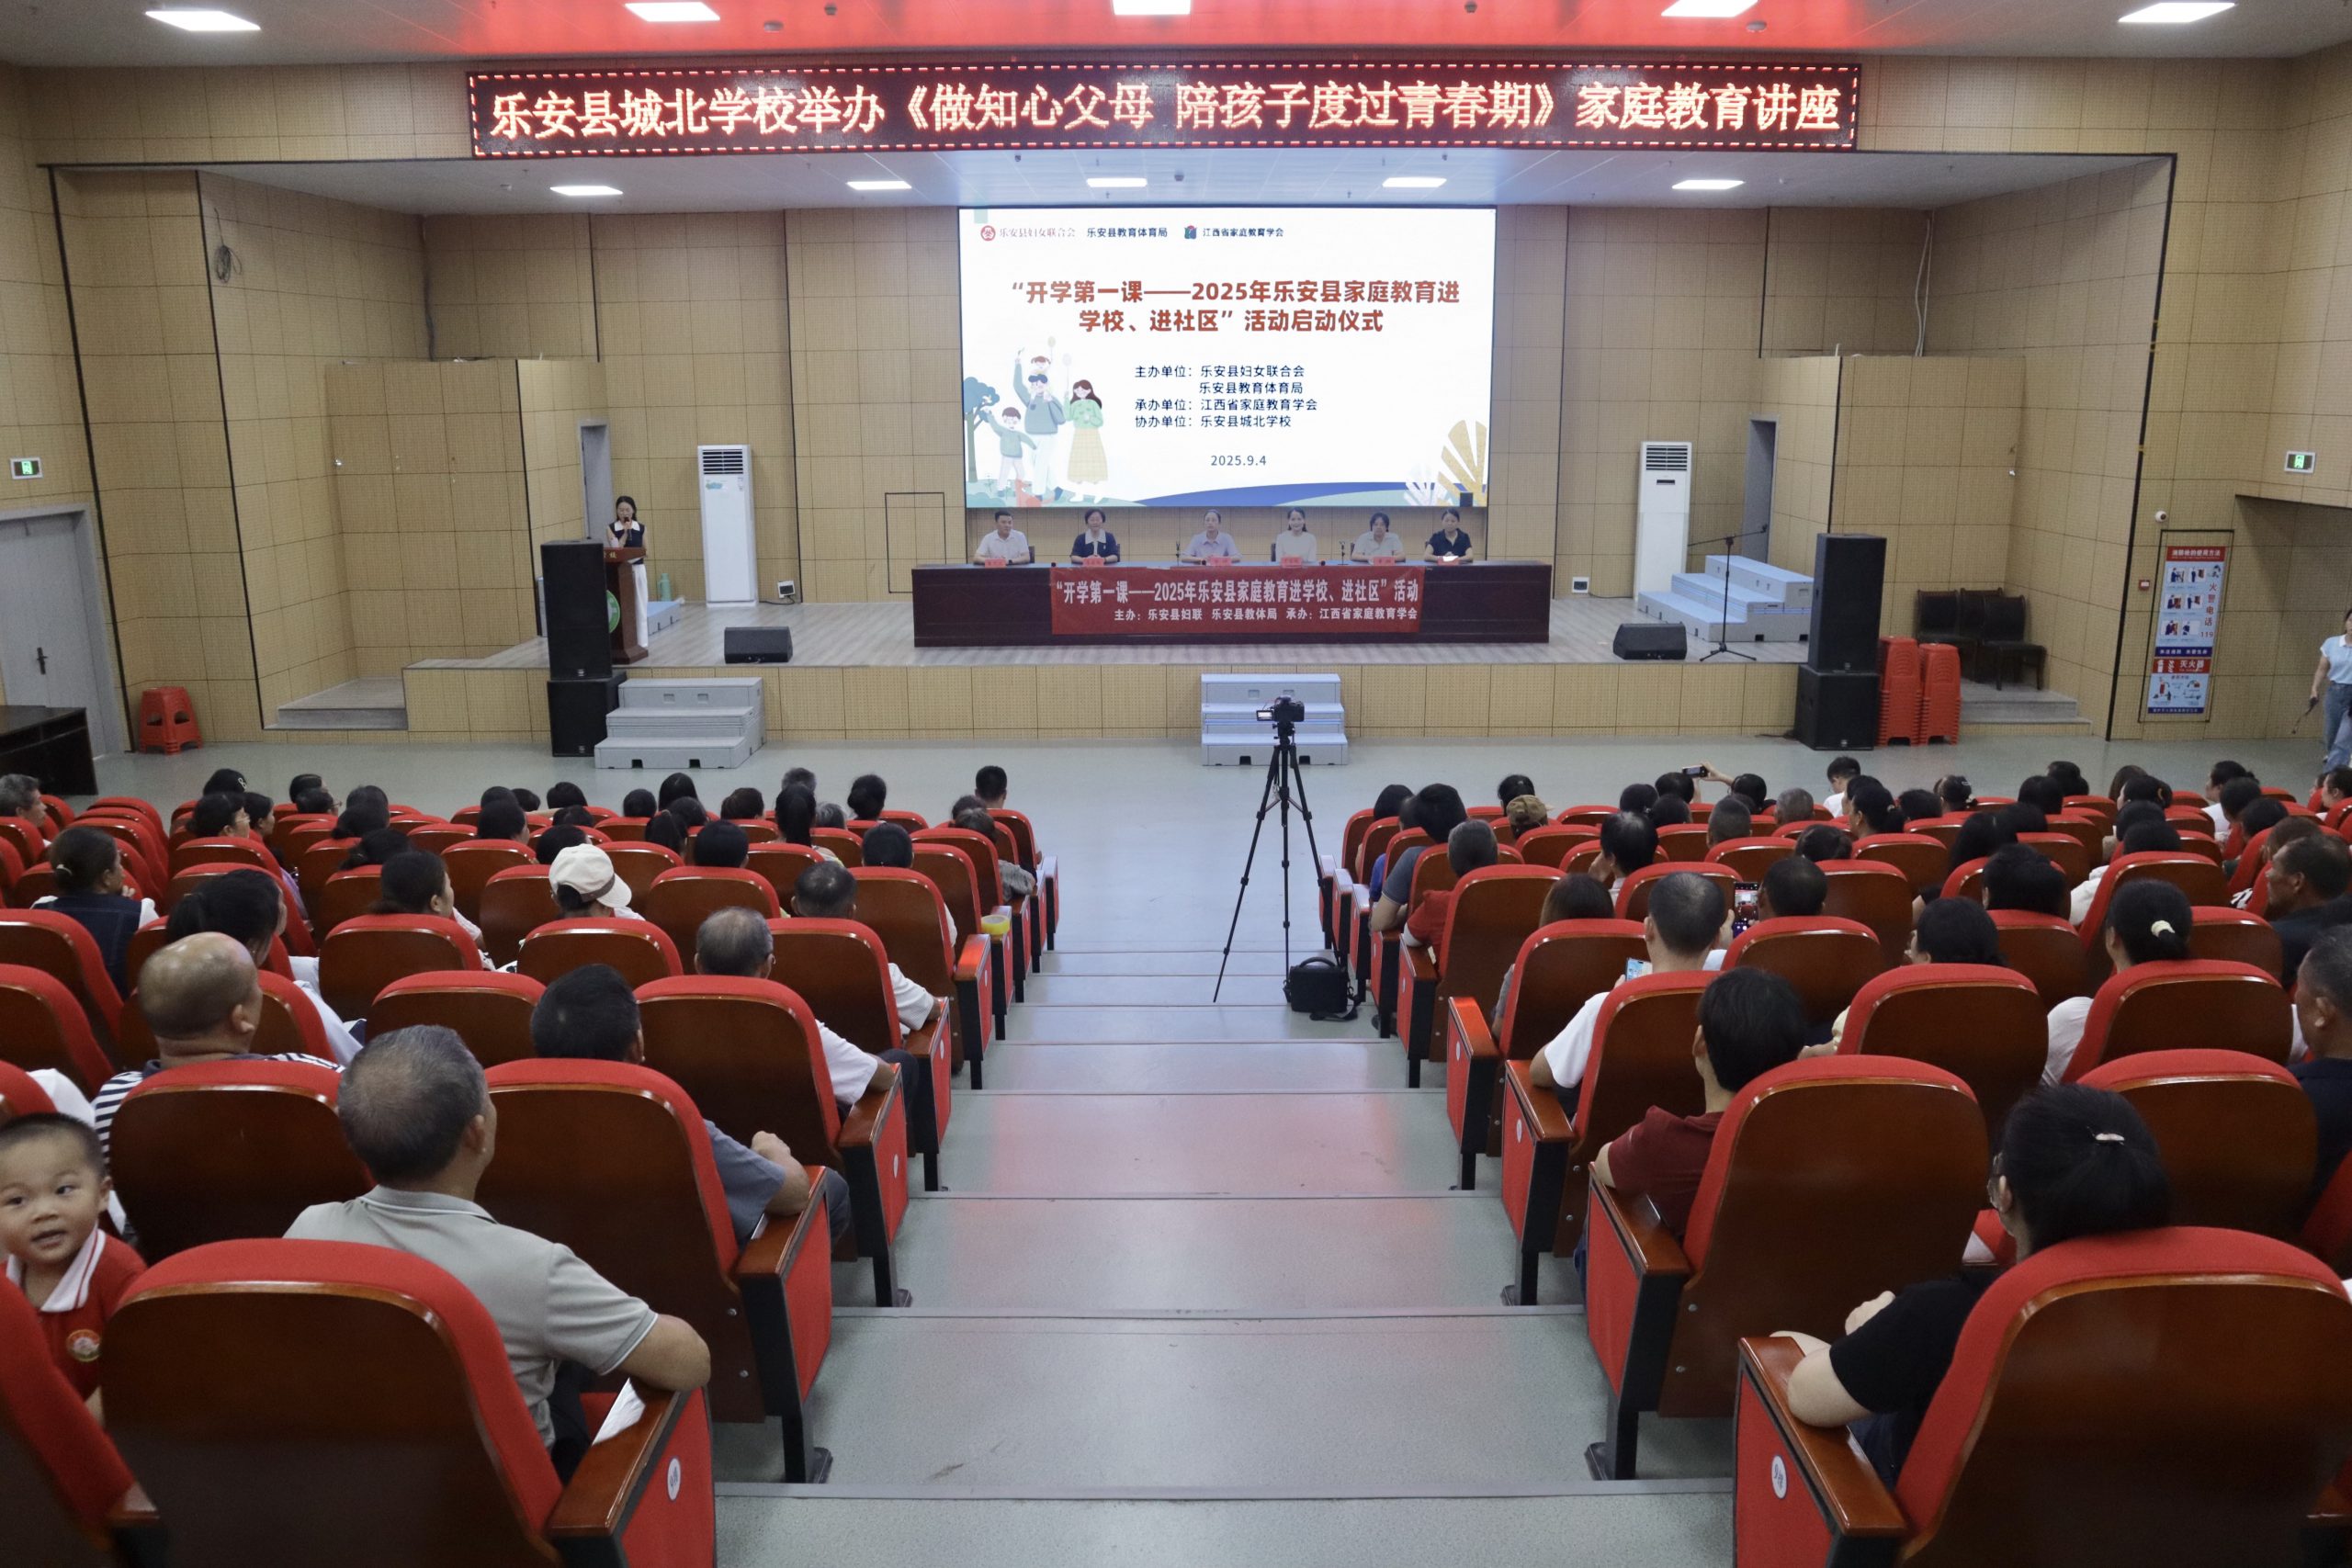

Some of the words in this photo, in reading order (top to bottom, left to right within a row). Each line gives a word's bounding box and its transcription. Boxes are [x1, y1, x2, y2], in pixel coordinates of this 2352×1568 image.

[1087, 227, 1168, 238] 乐安县教育体育局
[1203, 227, 1284, 237] 江西省家庭教育学会
[1199, 381, 1303, 394] 乐安县教育体育局
[1210, 455, 1267, 467] 2025.9.4
[1212, 608, 1277, 621] 乐安县教体局
